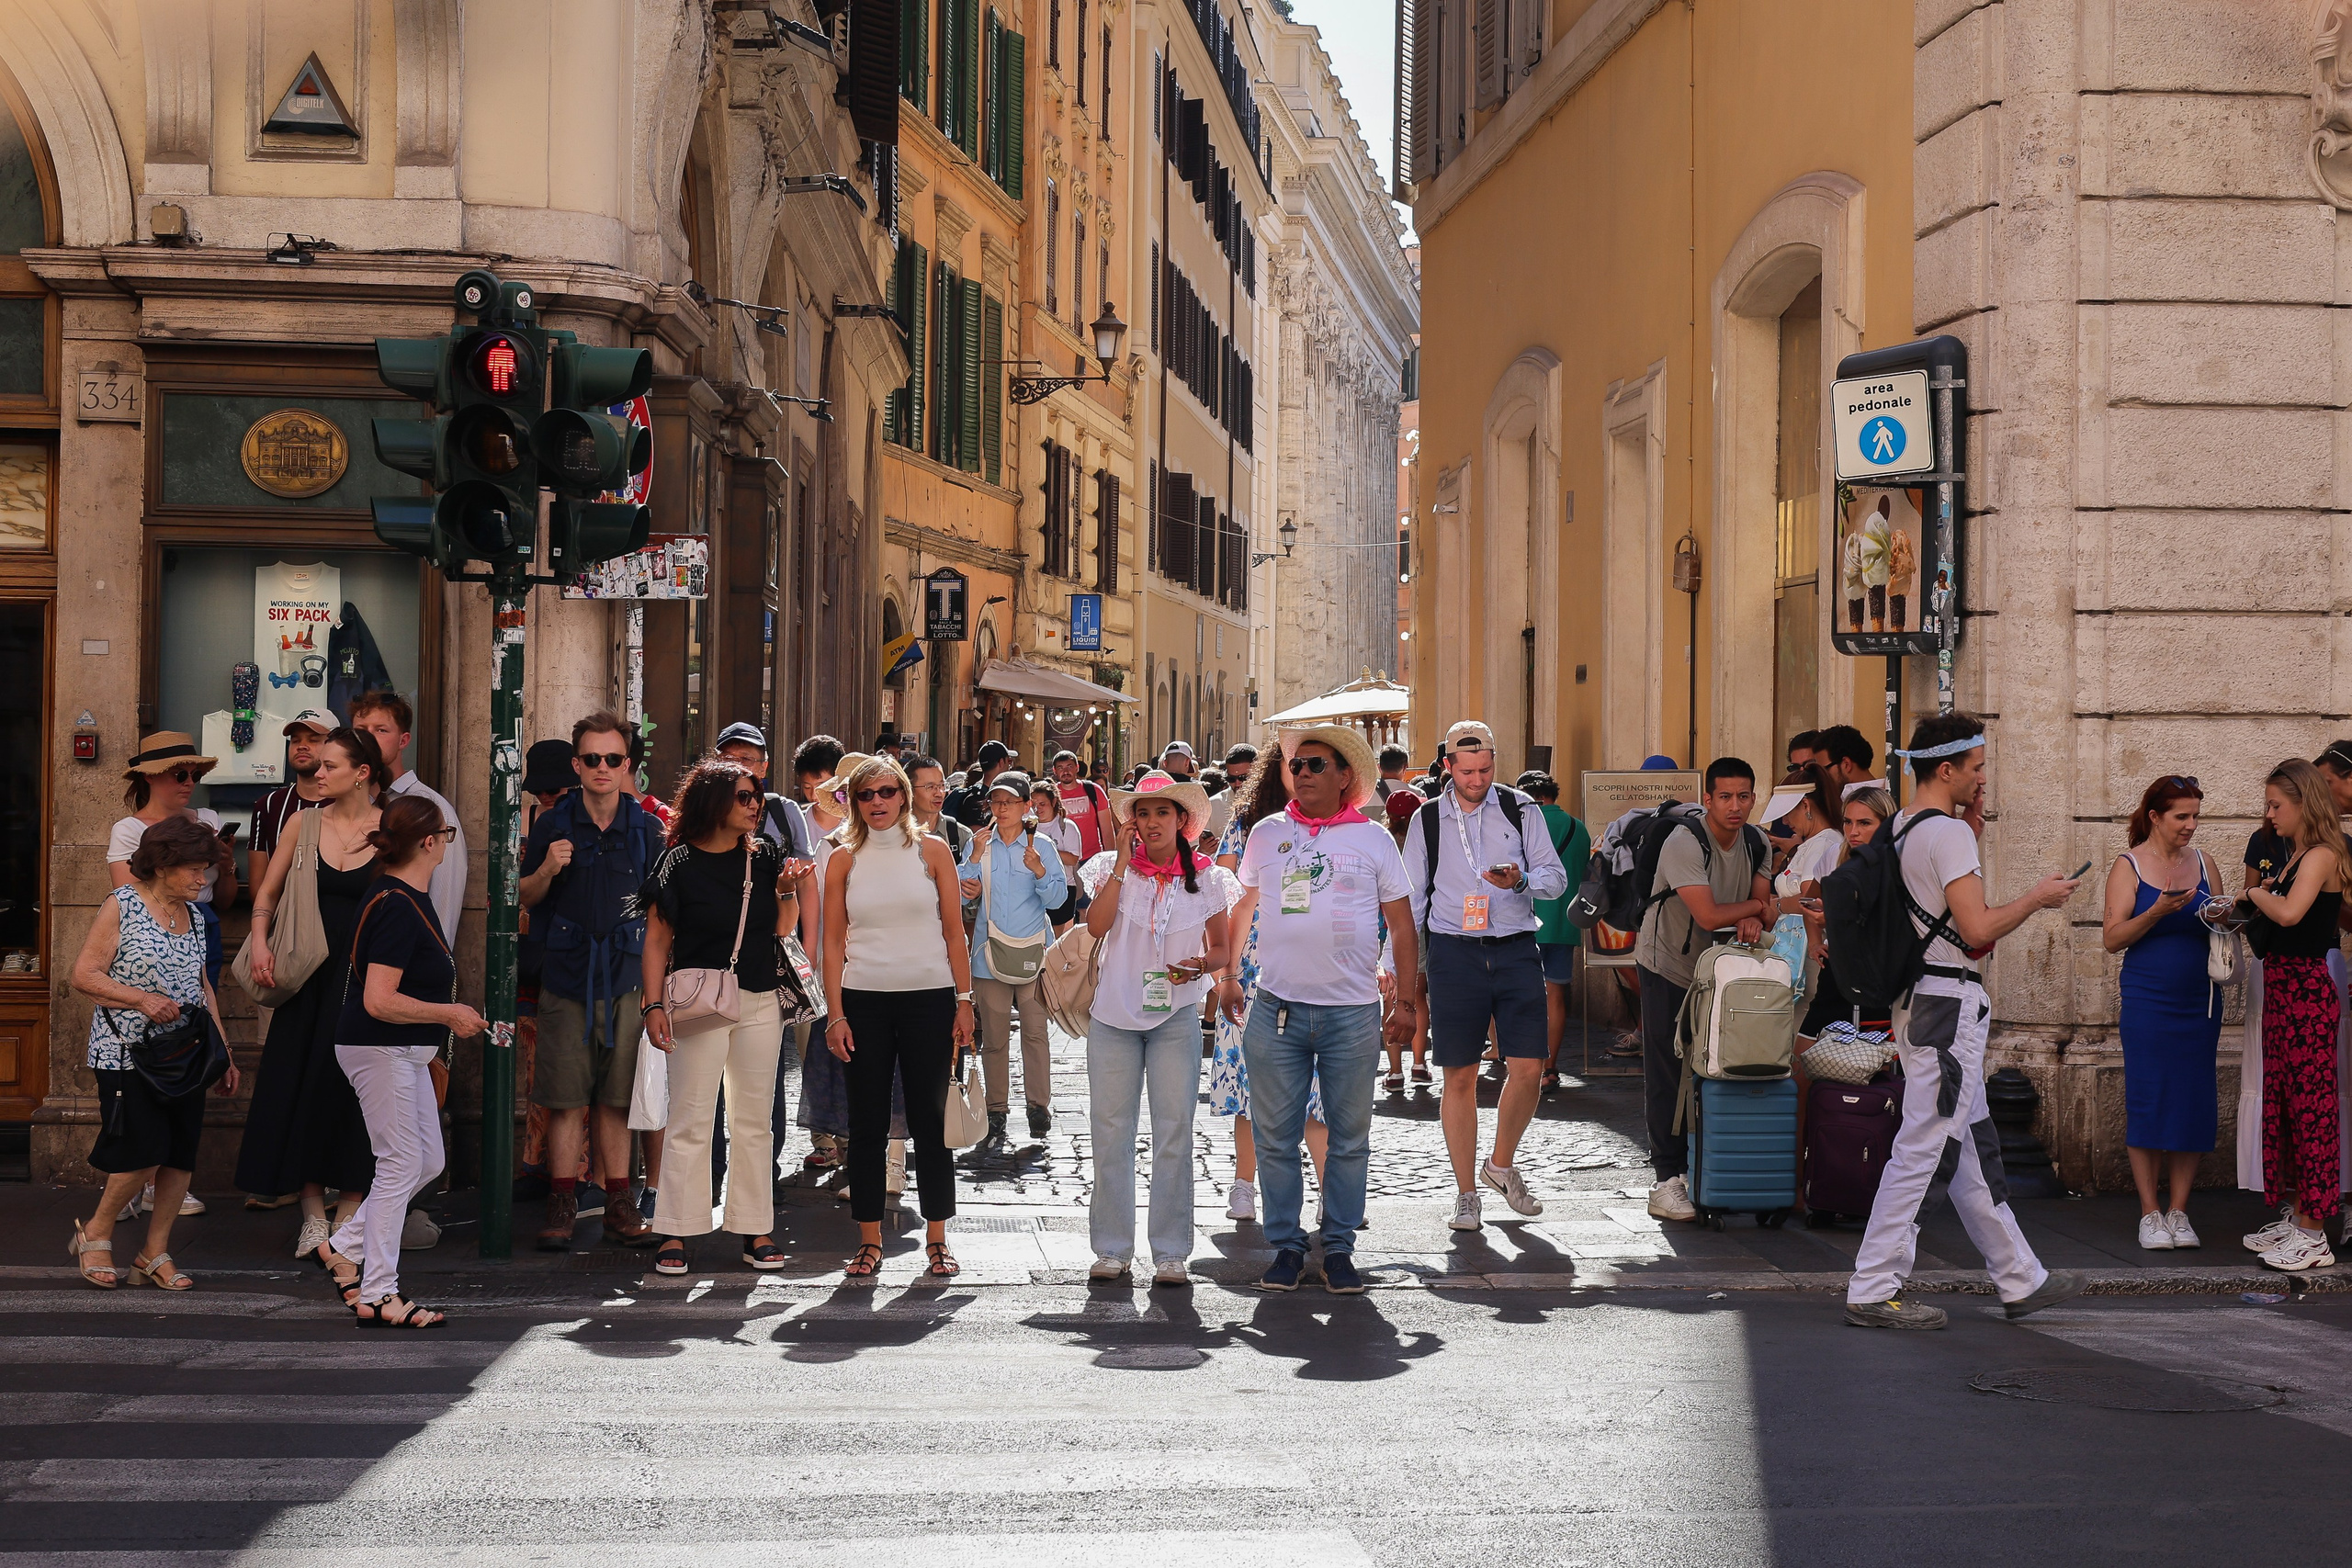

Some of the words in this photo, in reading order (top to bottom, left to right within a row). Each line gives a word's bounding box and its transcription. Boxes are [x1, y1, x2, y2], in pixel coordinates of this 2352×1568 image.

[1864, 383, 1894, 395] area
[82, 381, 139, 412] 334
[1849, 396, 1912, 415] pedonale
[270, 600, 304, 608] WORKING
[931, 581, 961, 620] T
[268, 607, 290, 621] SIX
[295, 608, 331, 622] PACK
[339, 647, 360, 656] MOJITO
[889, 645, 906, 657] ATM
[1333, 854, 1360, 866] NINE
[1340, 864, 1360, 874] NINE
